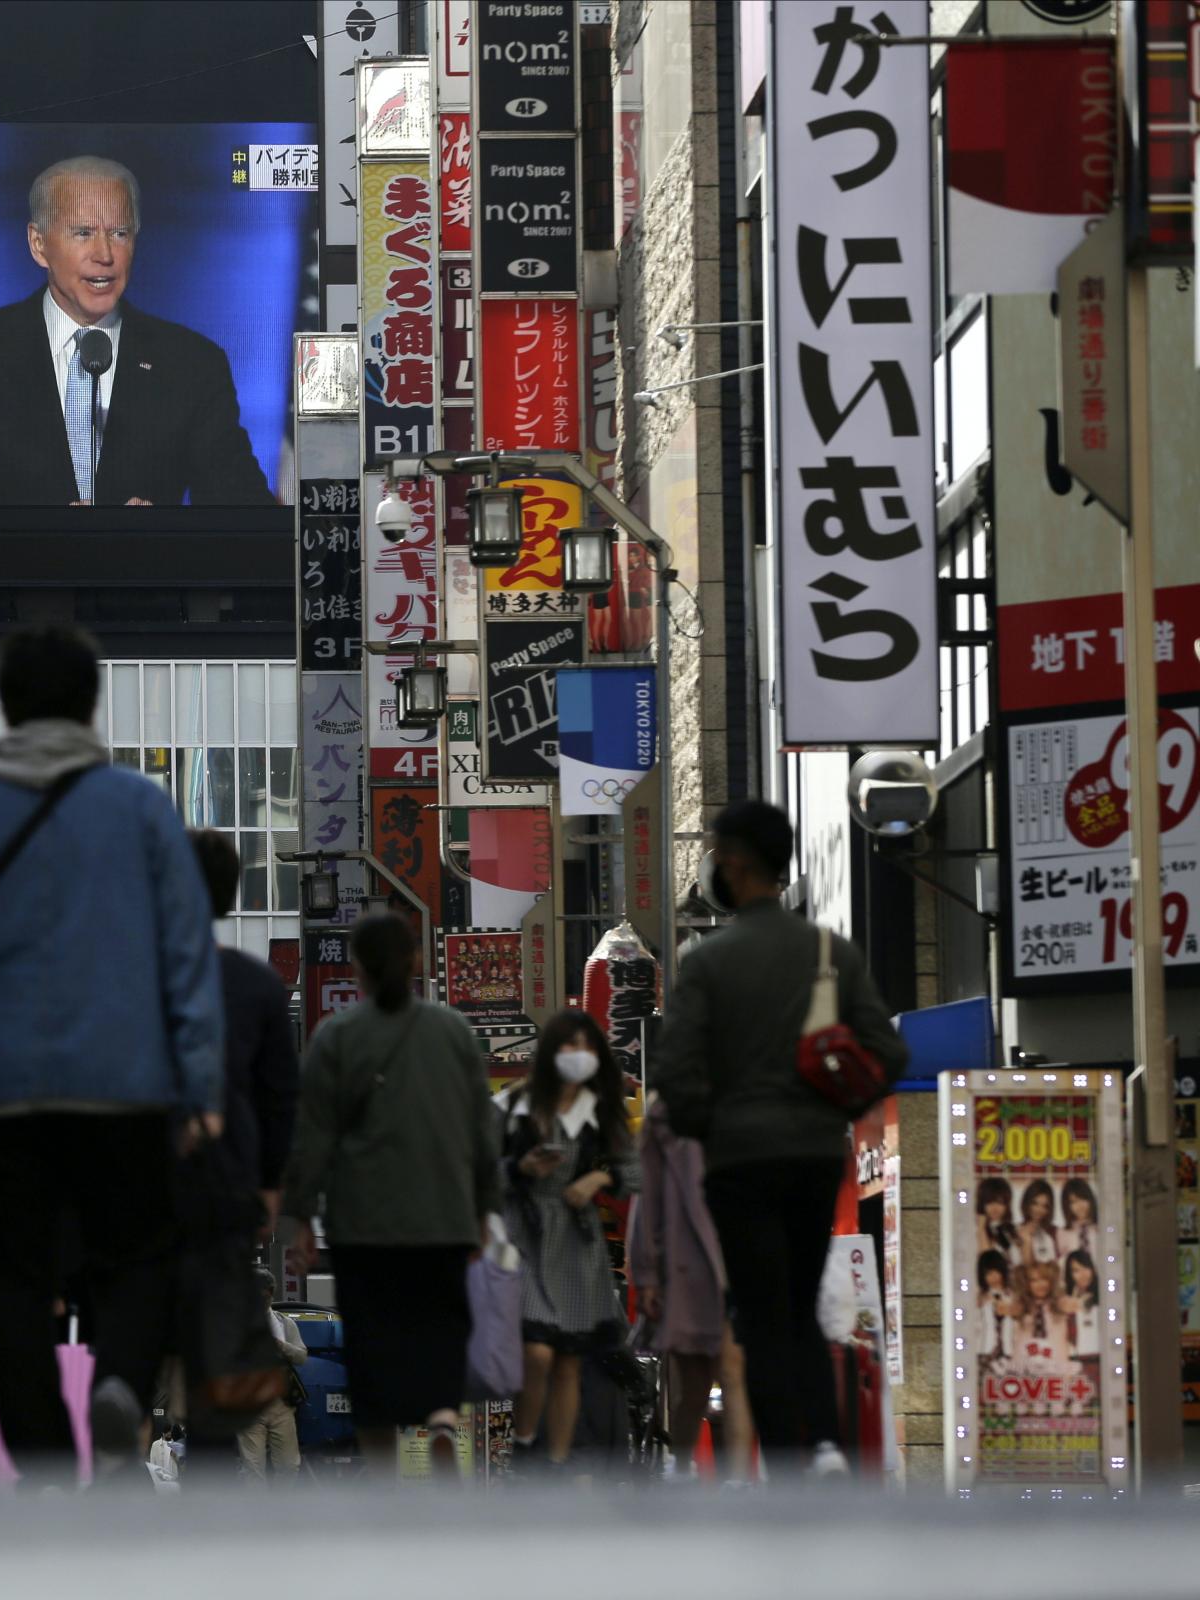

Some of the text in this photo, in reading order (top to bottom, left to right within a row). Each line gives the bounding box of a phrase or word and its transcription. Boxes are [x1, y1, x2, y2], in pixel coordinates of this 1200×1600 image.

[488, 4, 563, 17] Party Space
[521, 66, 546, 76] SINCE
[515, 100, 537, 114] 4F
[232, 151, 247, 183] 中継
[491, 164, 566, 178] Party Space
[523, 226, 549, 237] SINCE
[518, 261, 539, 275] 3F
[384, 176, 433, 406] まぐろ商店
[513, 302, 543, 450] リフレッシュ
[552, 395, 570, 444] ホステル
[487, 592, 580, 613] 博多天神
[490, 626, 575, 677] Party Space
[453, 710, 468, 726] 肉
[635, 680, 650, 766] TOKYO 2020
[314, 723, 363, 735] RESTAURAN
[451, 727, 472, 735] バル
[1020, 865, 1108, 902] 生ビール
[986, 1376, 1062, 1401] LOVE
